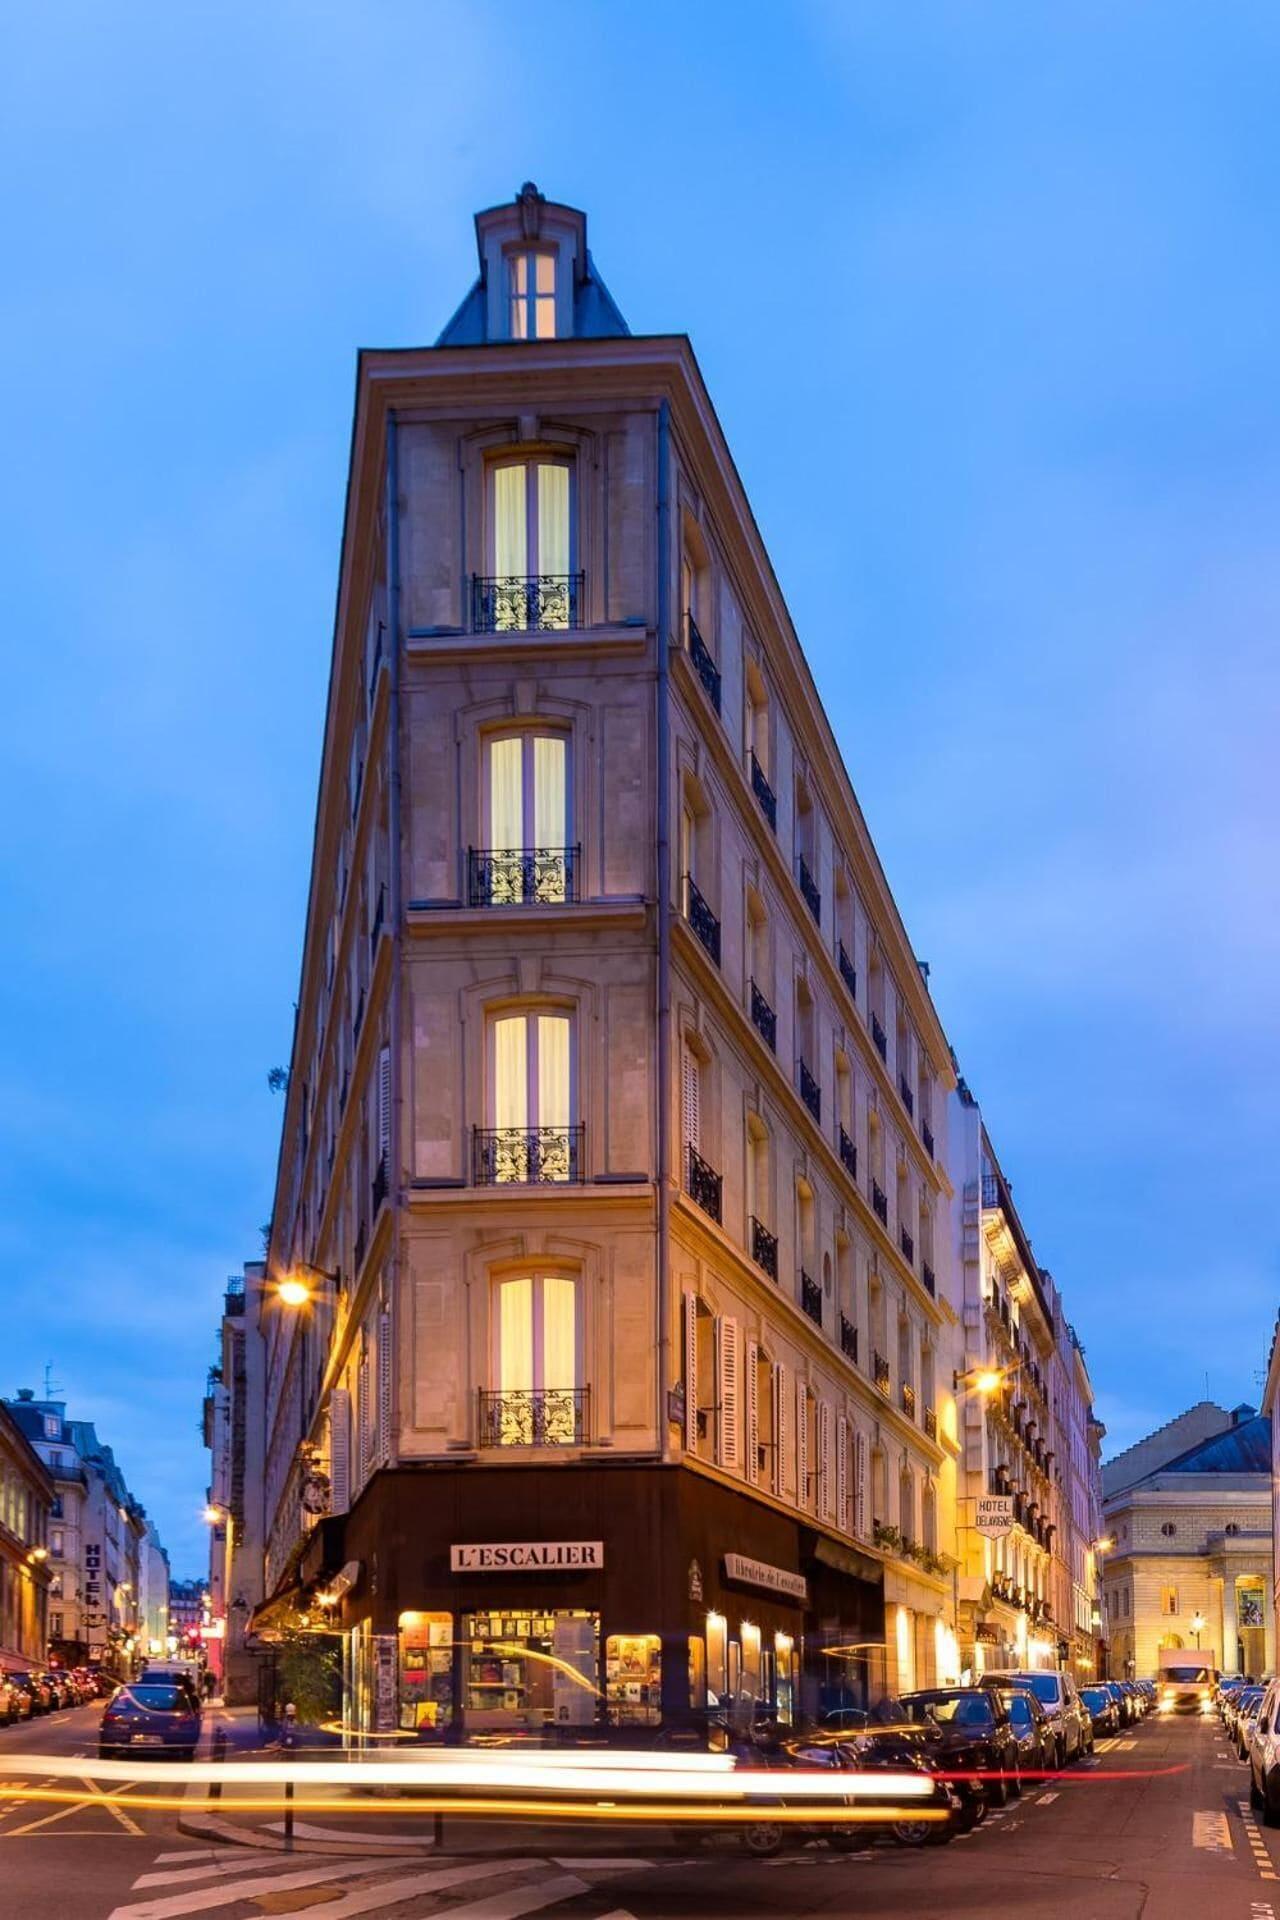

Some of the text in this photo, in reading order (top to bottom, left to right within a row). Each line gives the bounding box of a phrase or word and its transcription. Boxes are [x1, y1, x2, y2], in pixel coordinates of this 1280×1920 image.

[980, 1501, 1010, 1512] HOTEL
[458, 1547, 596, 1567] L'ESCALIER
[86, 1544, 100, 1606] HOTEL
